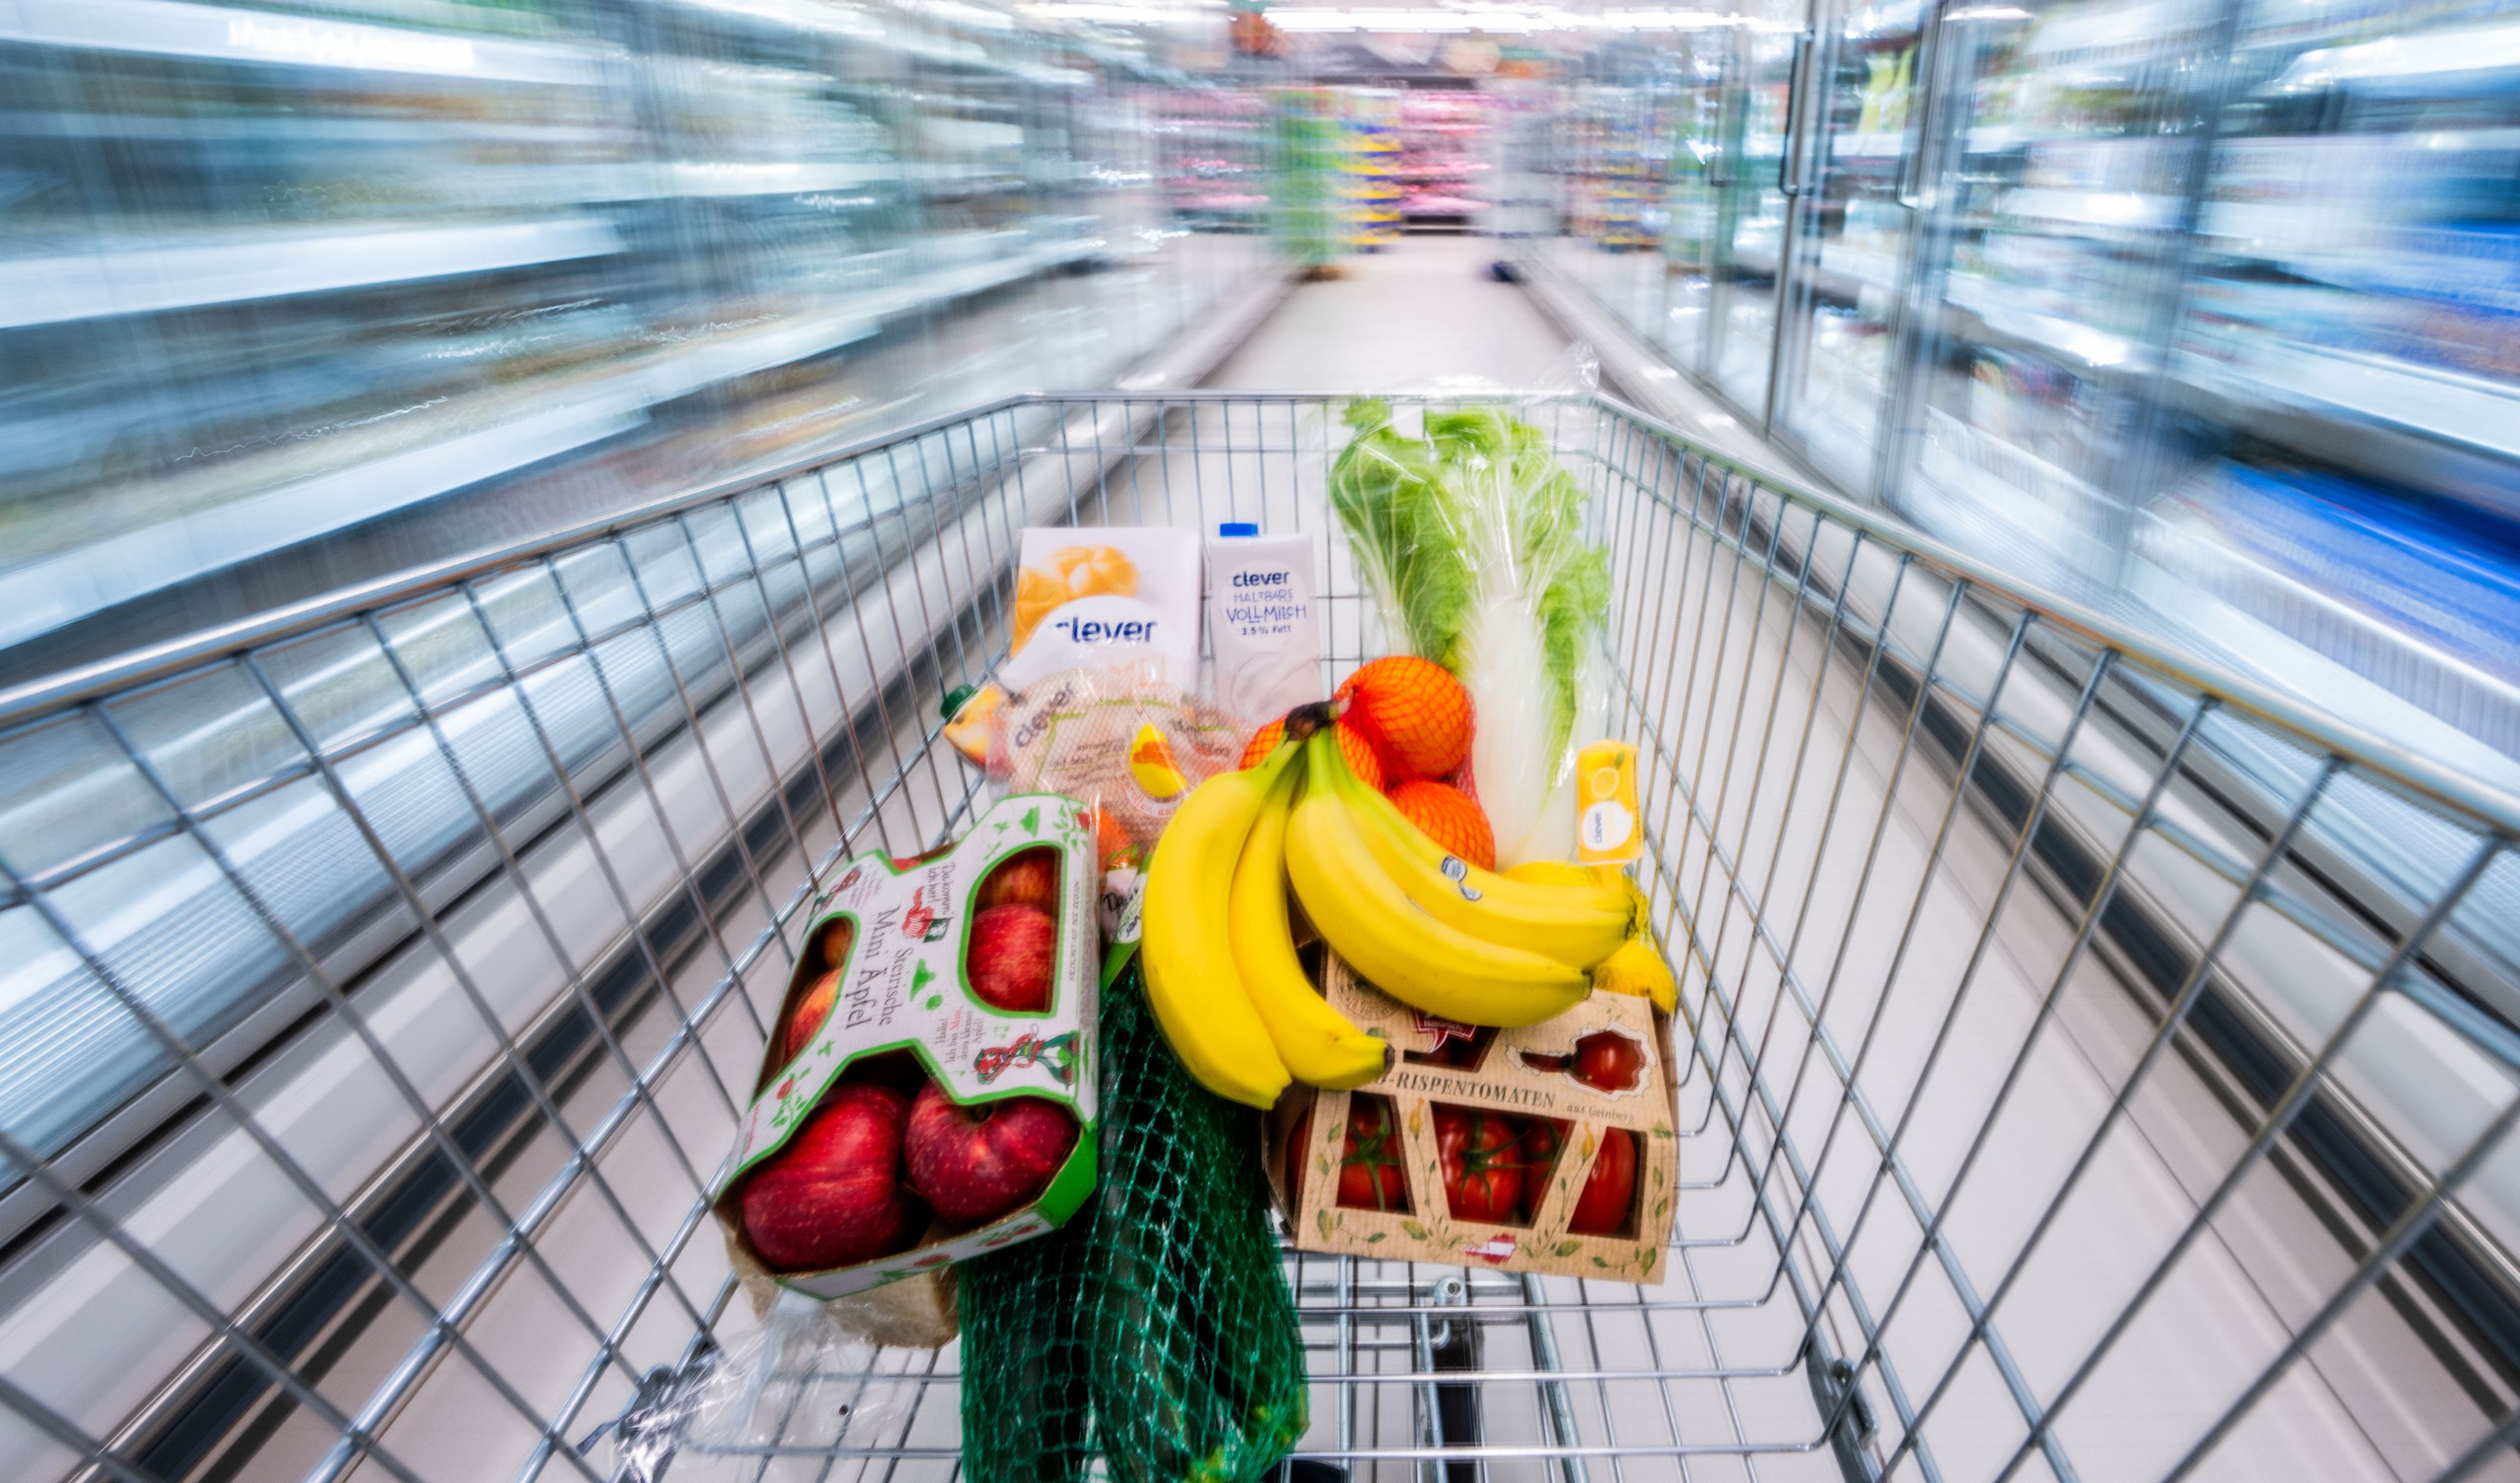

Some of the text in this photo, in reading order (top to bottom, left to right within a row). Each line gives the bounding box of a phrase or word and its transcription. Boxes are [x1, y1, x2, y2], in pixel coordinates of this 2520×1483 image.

[1233, 570, 1290, 587] clever
[1234, 588, 1294, 603] HALTBARE
[942, 862, 955, 881] Da
[844, 904, 901, 1030] Mini Äpfel
[879, 947, 914, 1026] Steirische
